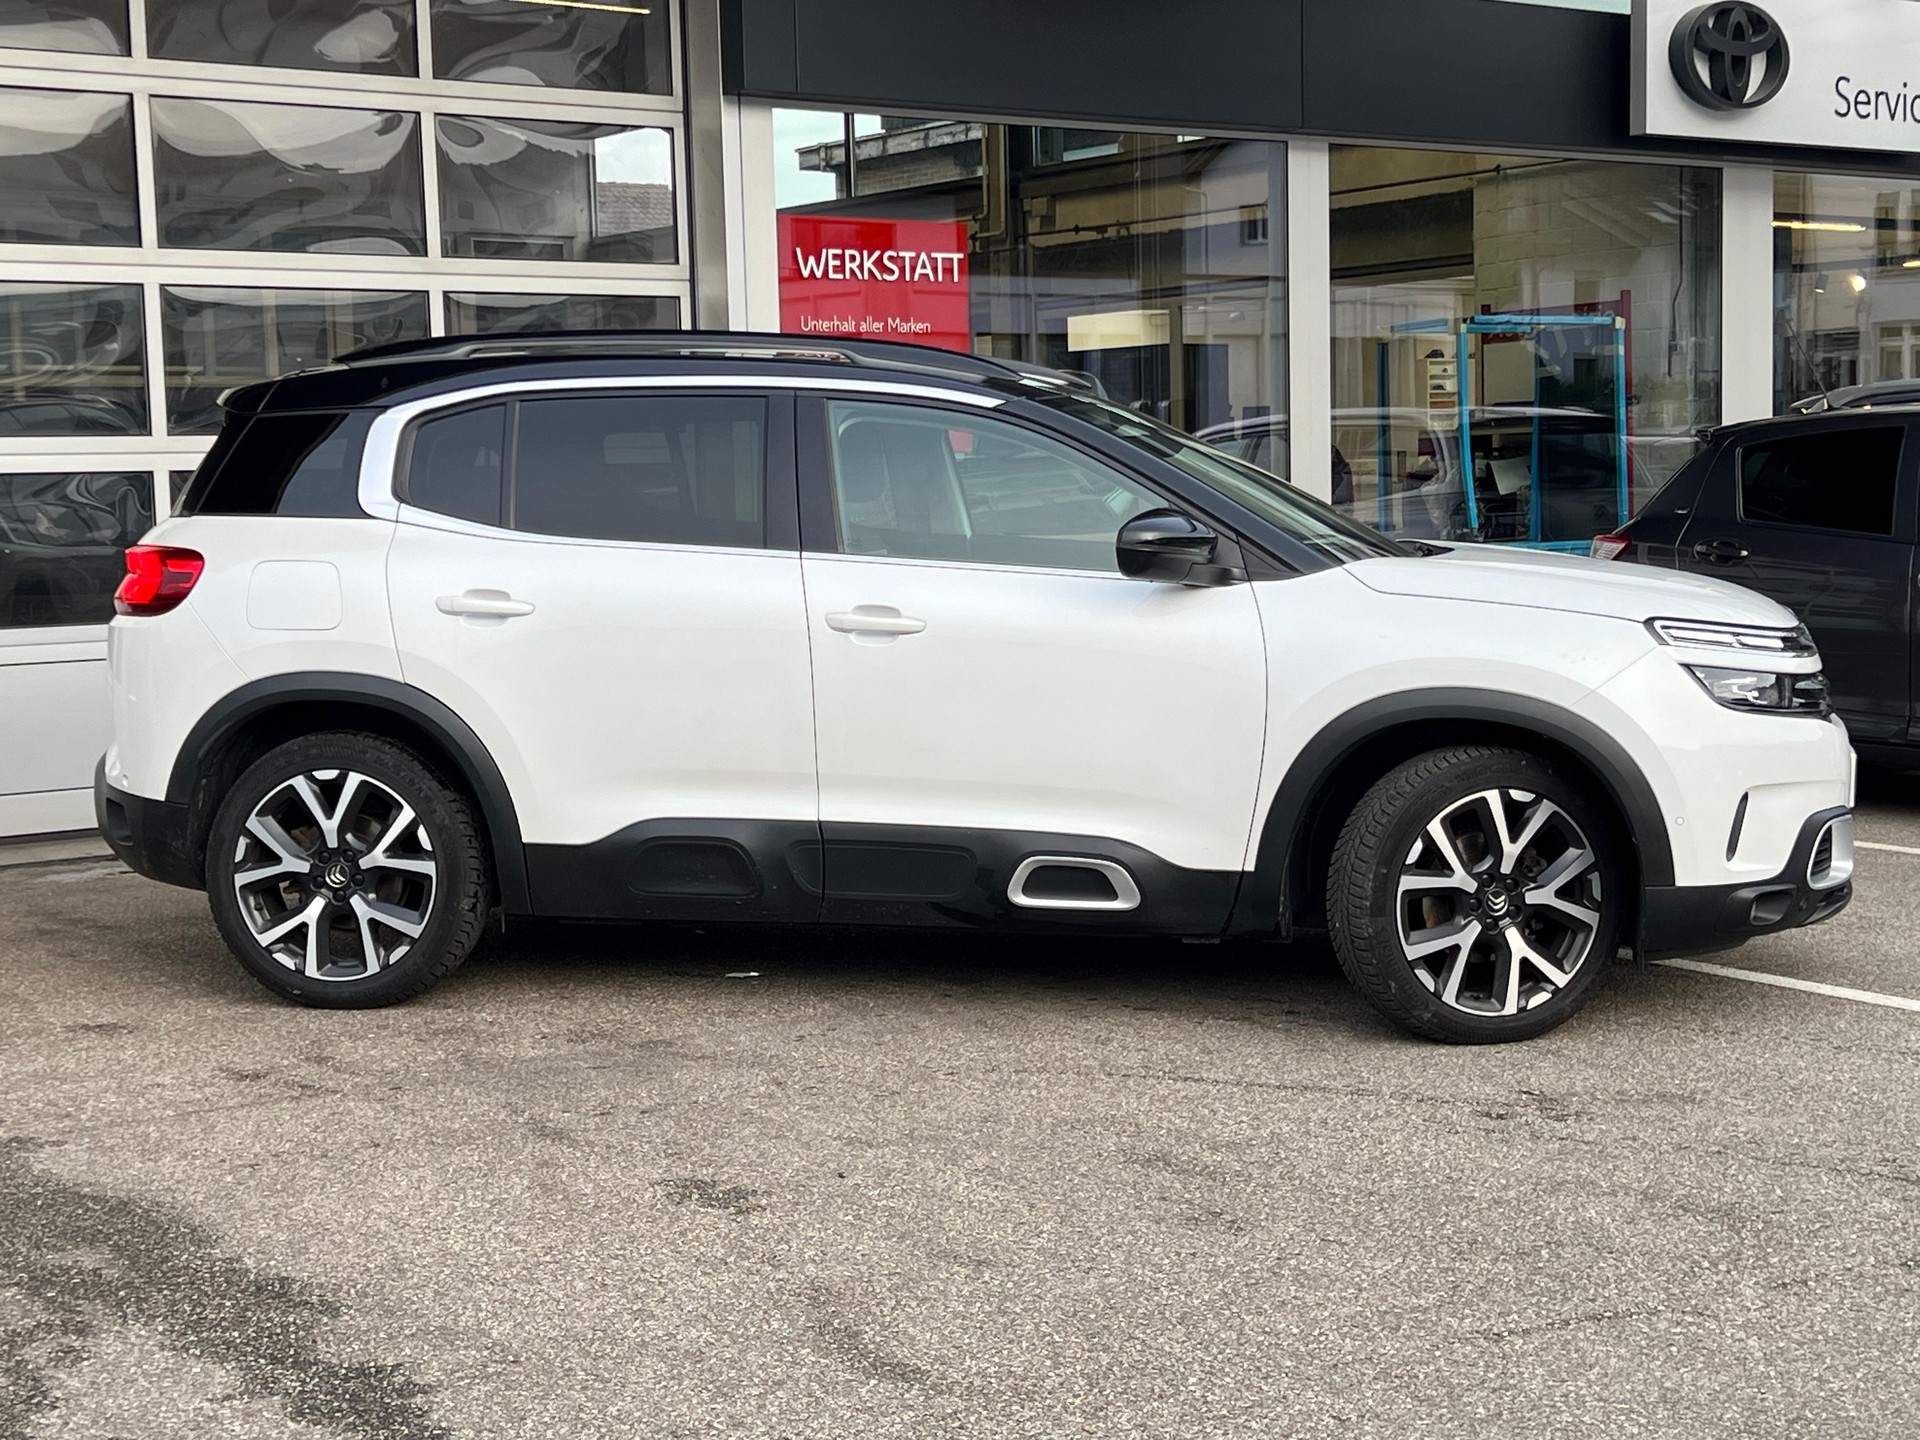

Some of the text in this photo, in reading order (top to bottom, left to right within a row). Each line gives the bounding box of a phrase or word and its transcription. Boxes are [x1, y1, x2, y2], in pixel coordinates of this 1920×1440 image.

[1834, 75, 1920, 124] Servic
[795, 247, 965, 283] WERKSTATT
[800, 315, 931, 334] Unterhalt aller Marken
